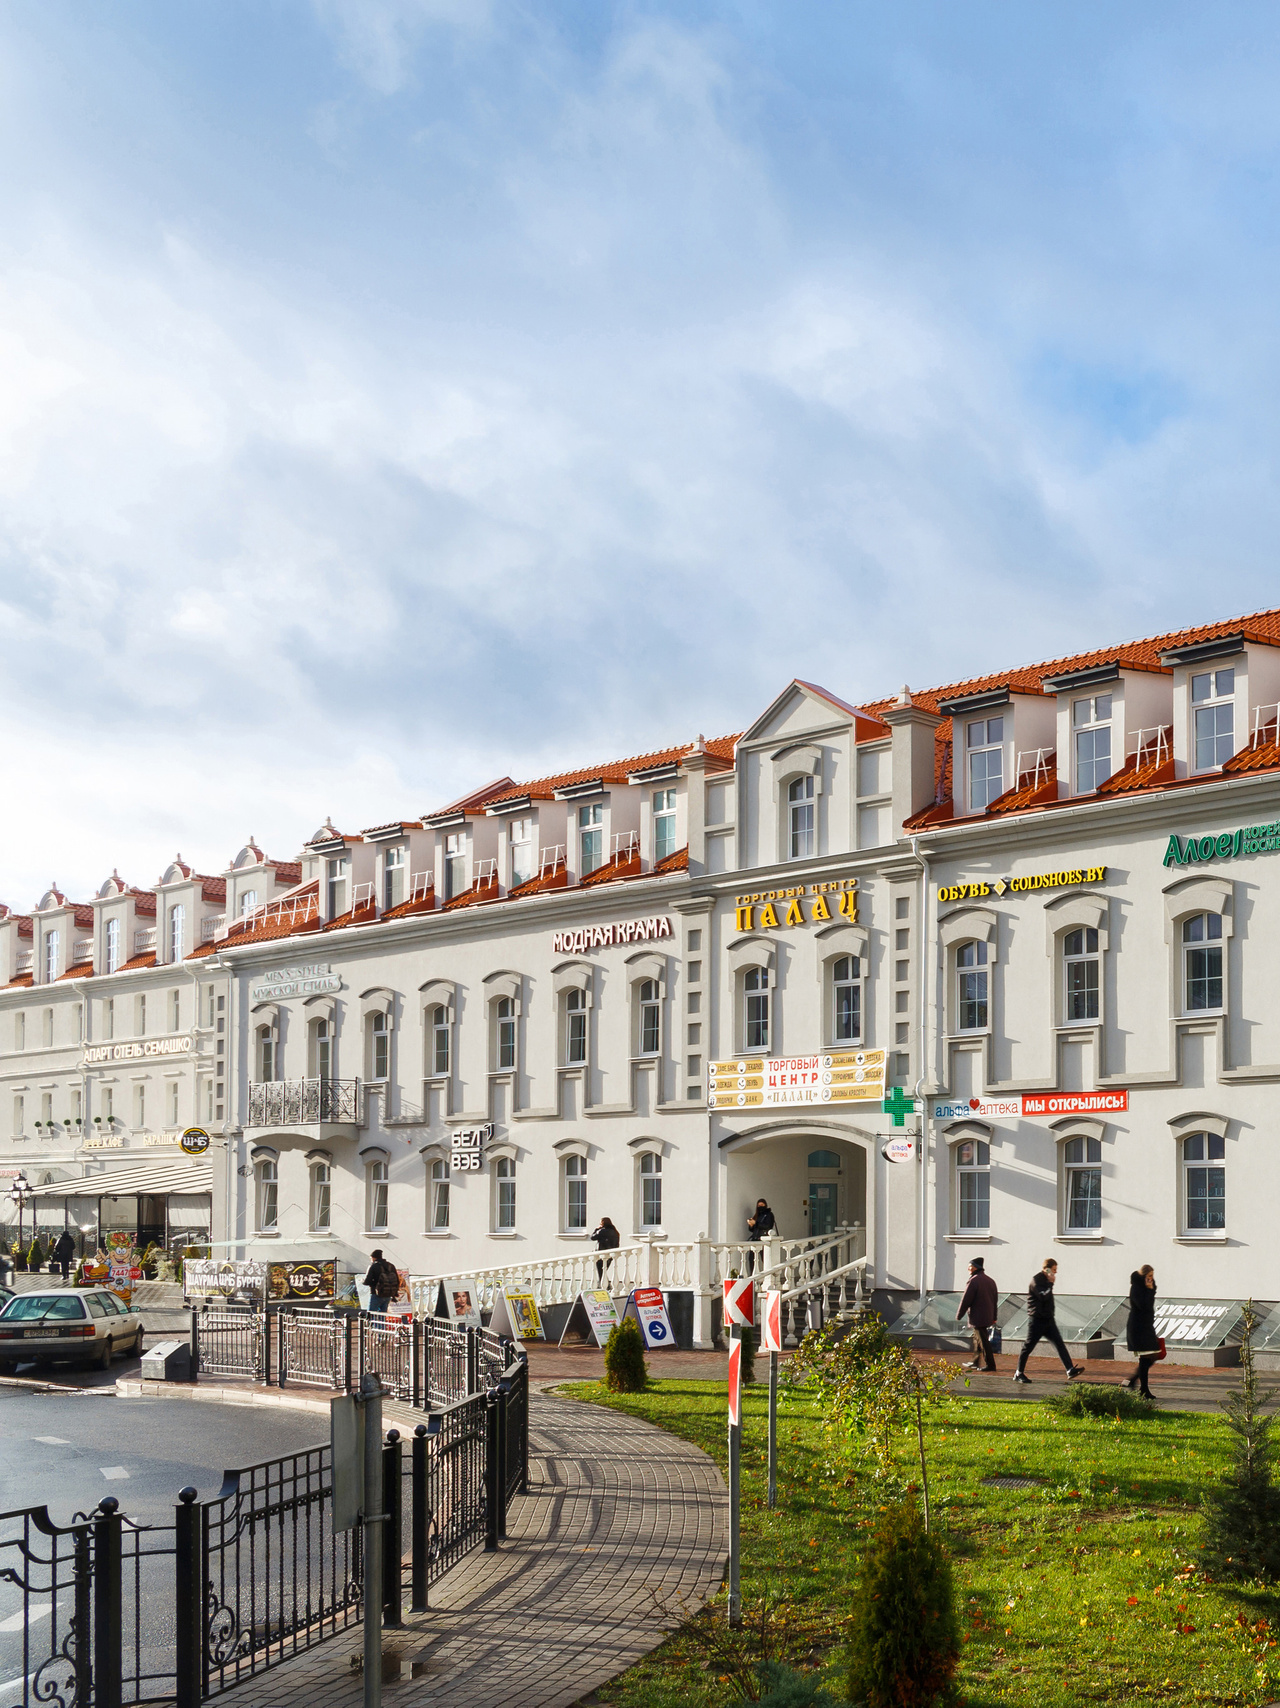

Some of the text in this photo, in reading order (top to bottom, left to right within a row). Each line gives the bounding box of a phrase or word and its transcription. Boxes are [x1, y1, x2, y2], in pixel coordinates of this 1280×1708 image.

[1010, 866, 1107, 892] GOLDSHOES.BY
[735, 879, 857, 905] ТОРГОВЫЙ ЦЕНТР
[937, 882, 990, 901] ОБУВЬ
[735, 889, 860, 931] ПАЛАЦ
[553, 917, 673, 953] МОДНАЯ КРАМА
[297, 964, 328, 976] STYLE
[253, 980, 334, 998] МУЖСКОЙ СТИЛЬ
[84, 1037, 191, 1062] АПАРТ ОТЕЛЬ СЕМАШКО
[768, 1055, 819, 1072] ТОРГОВЫЙ
[768, 1072, 819, 1087] ЦЕНТР
[935, 1102, 1019, 1117] альфа аптека
[1025, 1096, 1125, 1112] МЫ ОТКРЫЛИСЬ!
[452, 1131, 481, 1147] БЕЛ
[452, 1154, 482, 1170] ВЭБ
[186, 1274, 219, 1287] ШАУРМА
[1155, 1303, 1228, 1317] ДУБЛЁНКИ
[524, 1329, 536, 1337] 50
